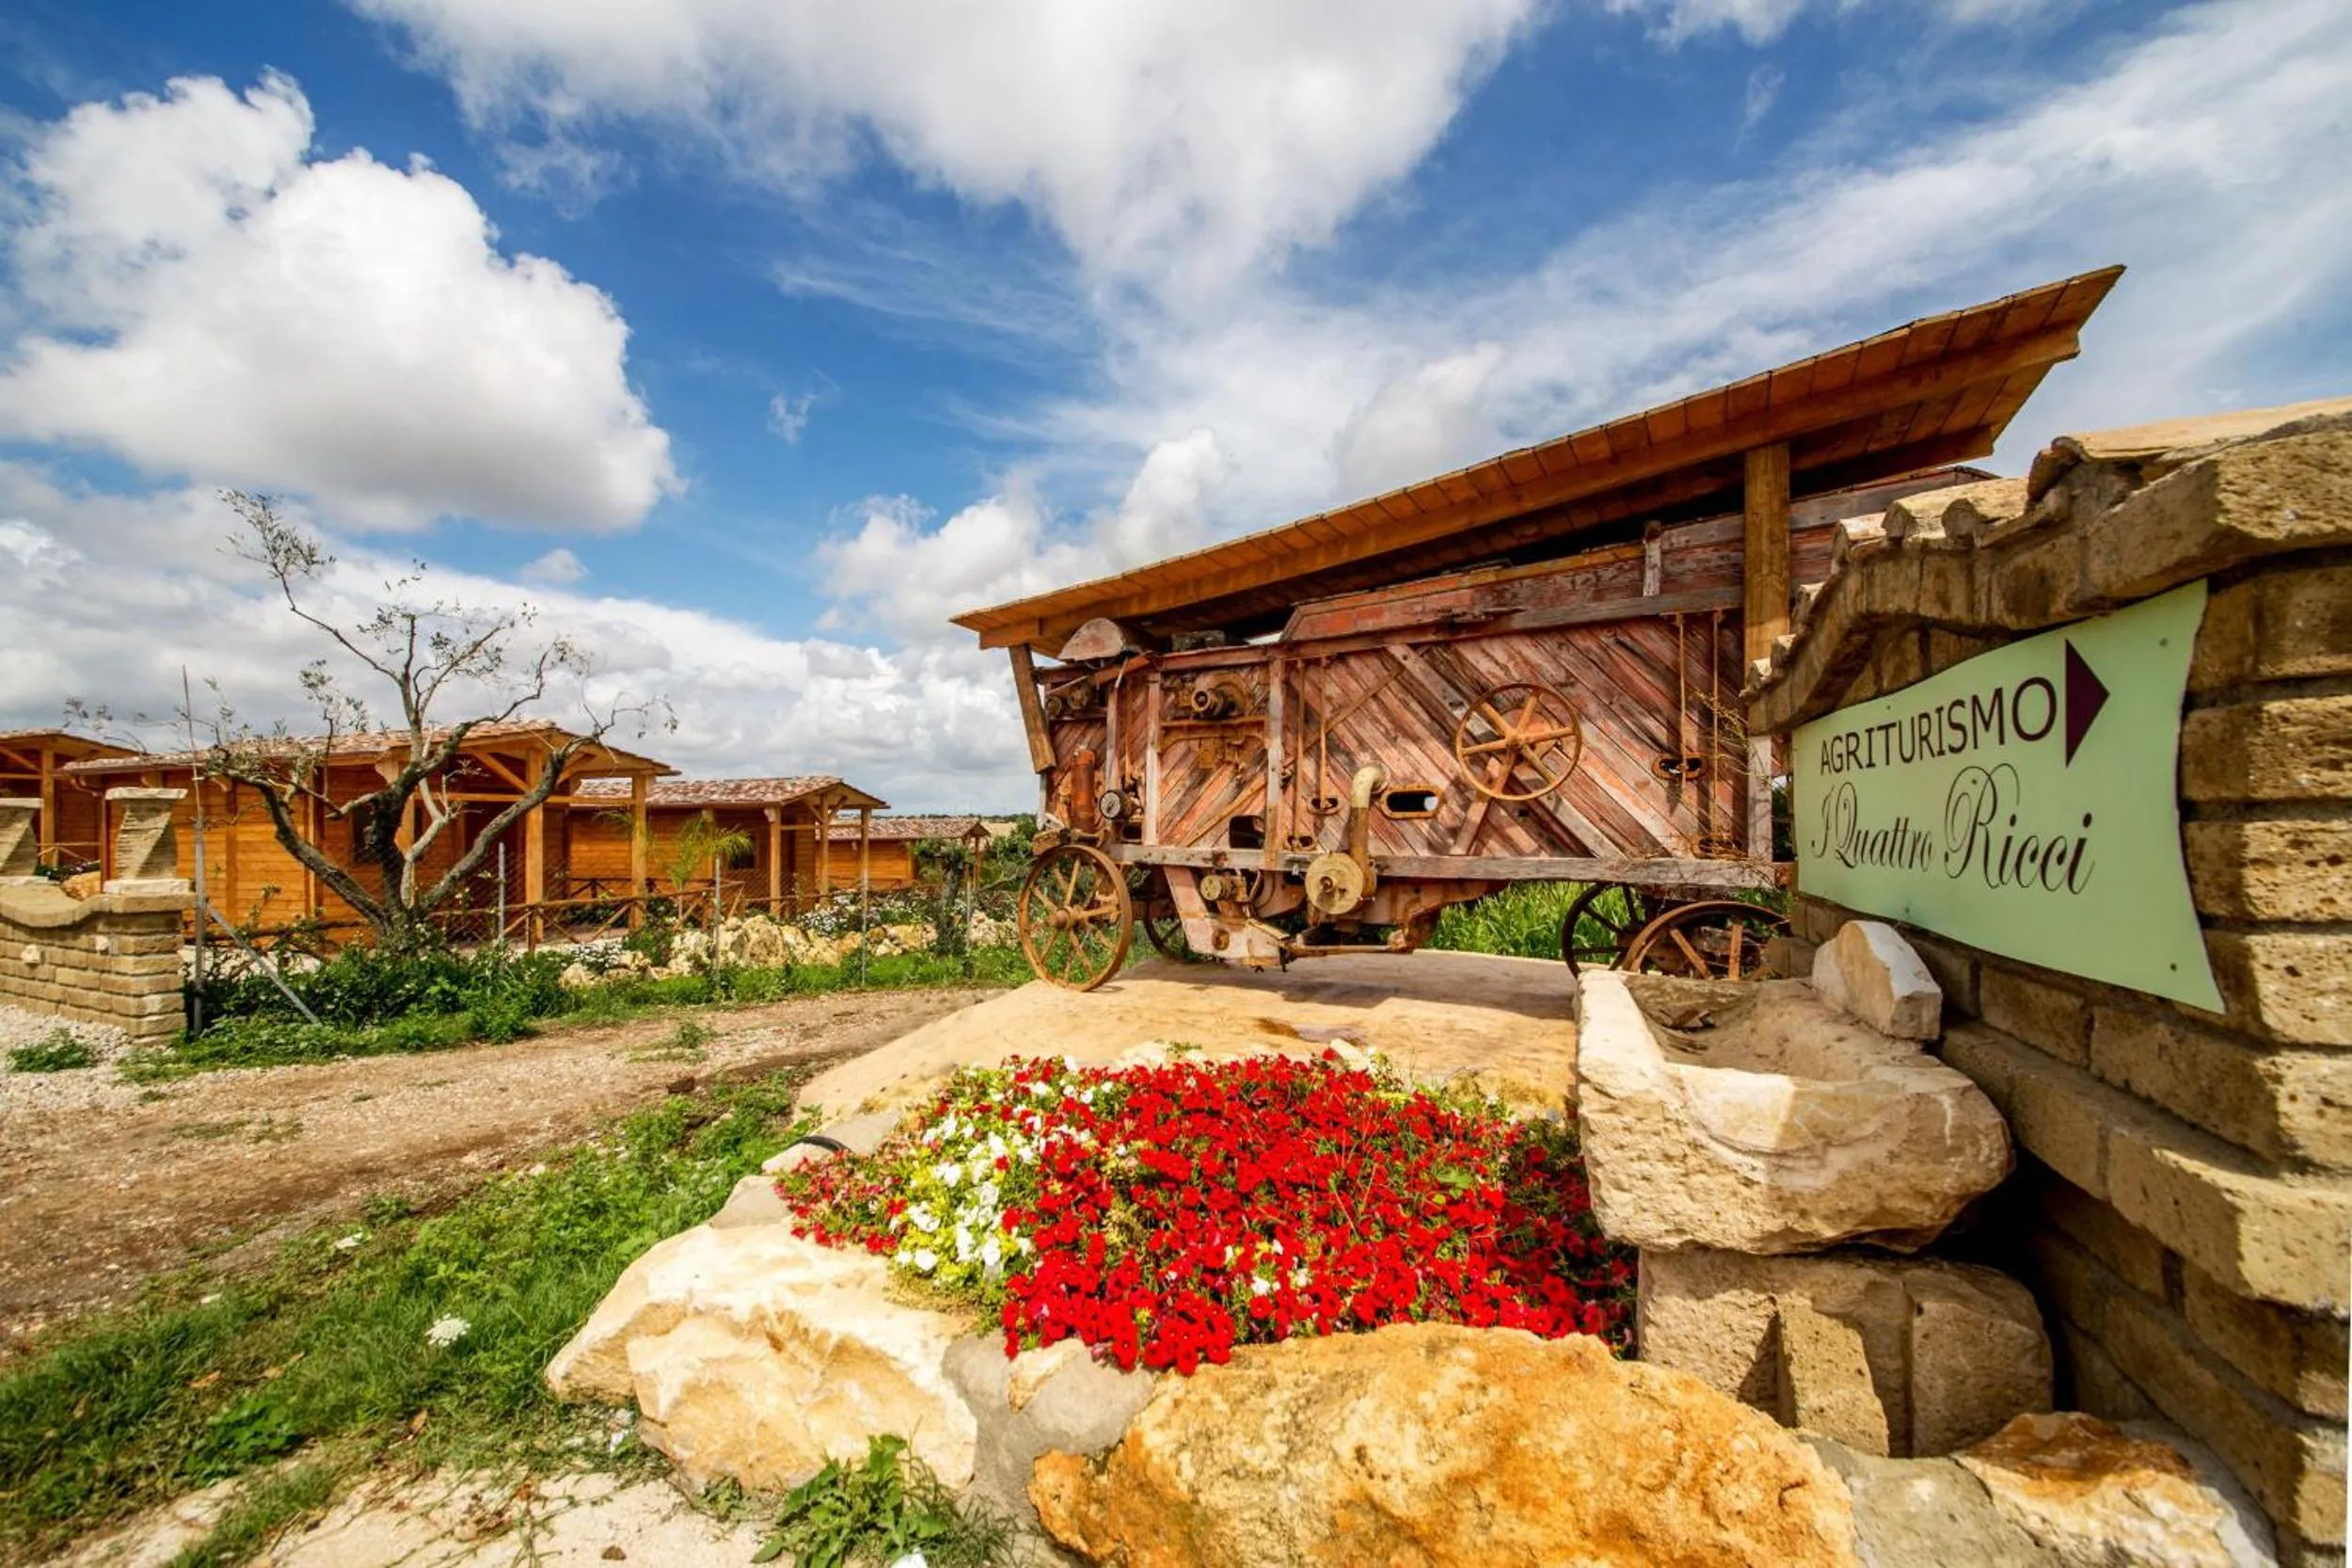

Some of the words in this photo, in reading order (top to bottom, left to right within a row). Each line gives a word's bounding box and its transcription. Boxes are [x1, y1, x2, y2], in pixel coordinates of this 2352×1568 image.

[1820, 676, 2058, 775] AGRITURISMO
[1836, 782, 1933, 873] Quattro
[1944, 763, 2096, 895] Ricci
